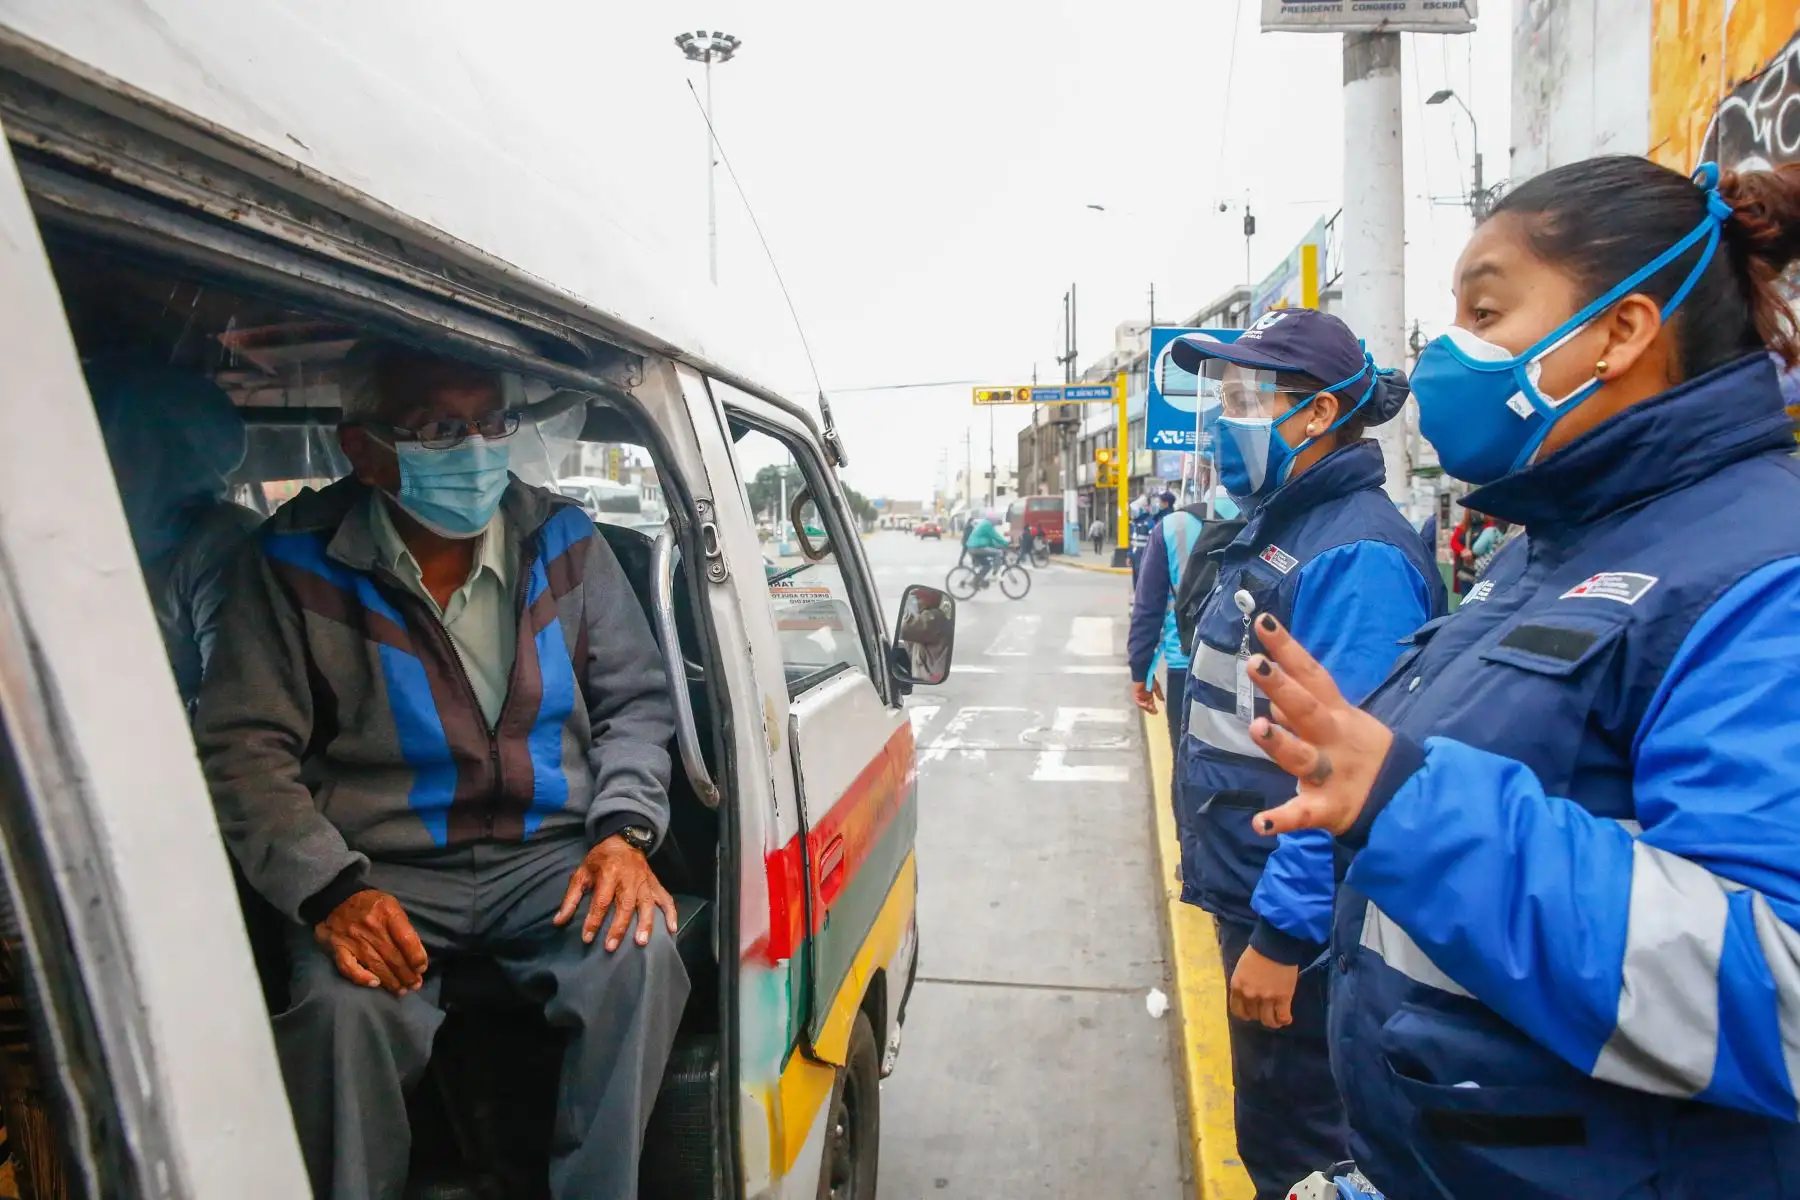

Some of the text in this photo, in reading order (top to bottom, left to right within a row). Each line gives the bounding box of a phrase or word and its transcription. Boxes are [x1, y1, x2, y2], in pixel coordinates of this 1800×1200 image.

[1280, 4, 1343, 14] PRESIDENTE
[1352, 3, 1406, 12] CONGRESO
[1153, 430, 1185, 444] ATU
